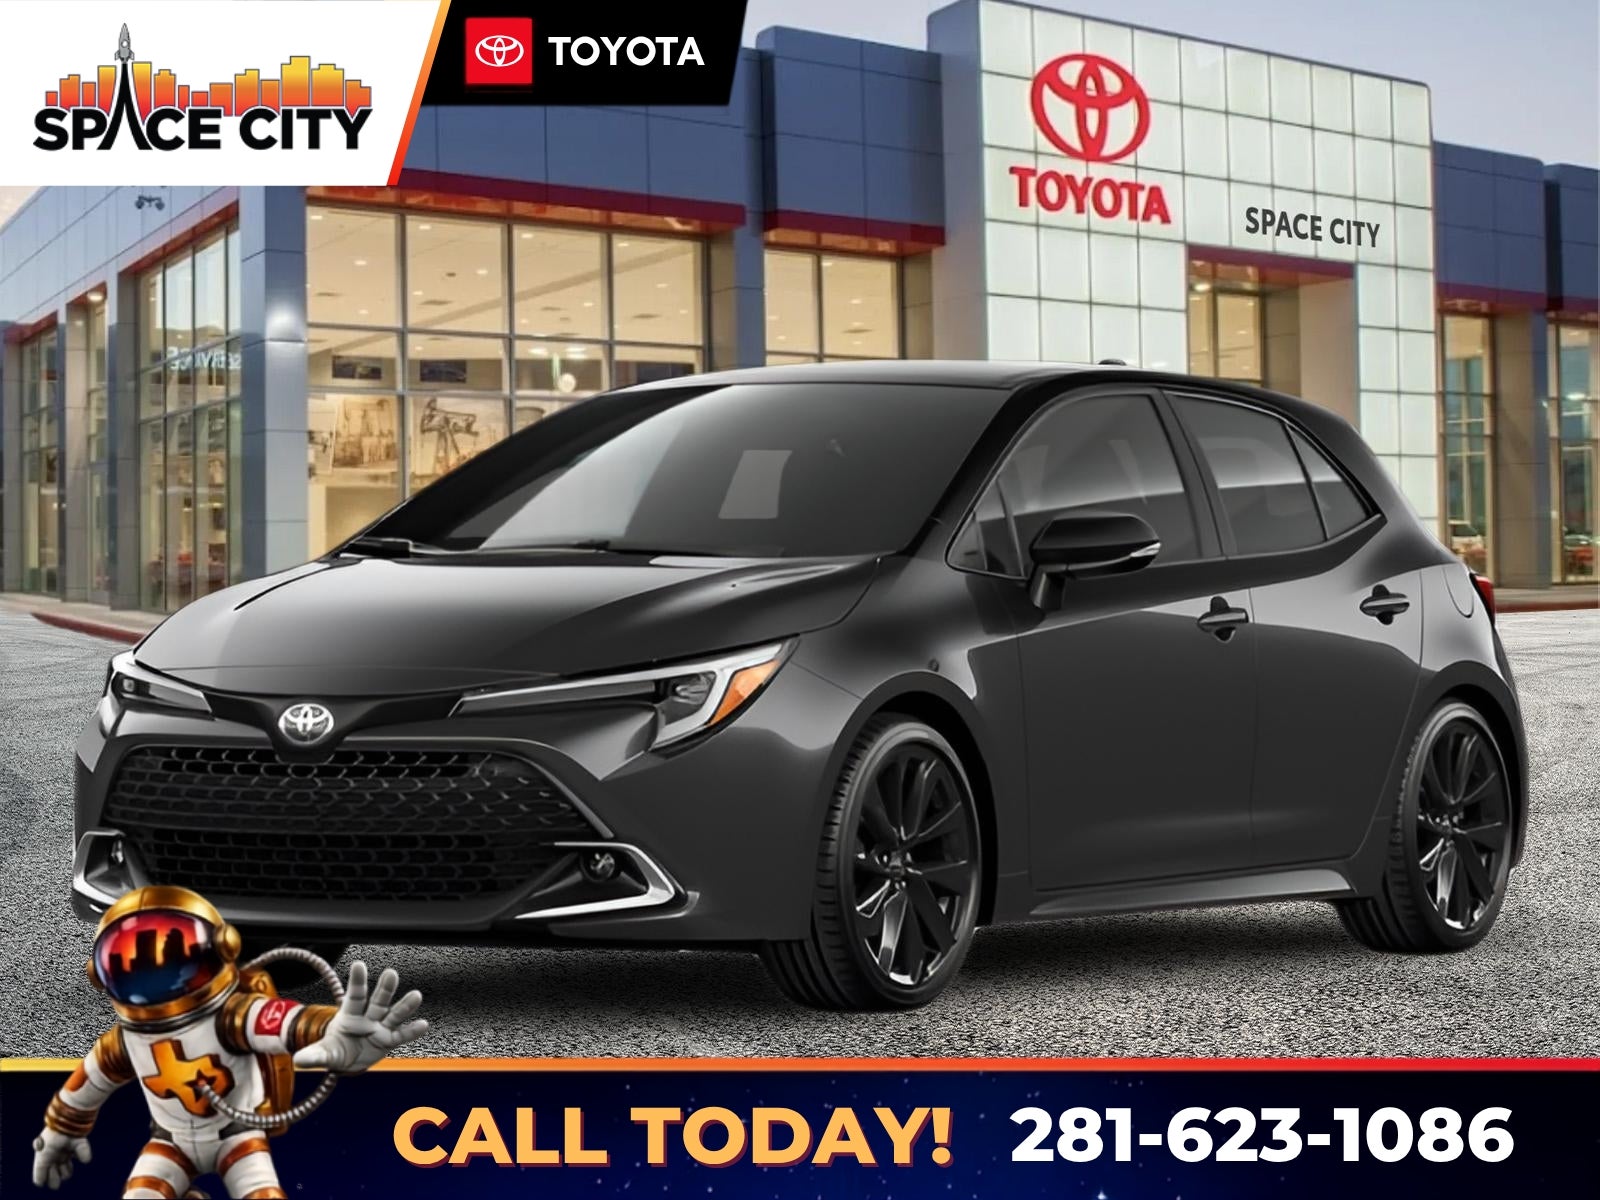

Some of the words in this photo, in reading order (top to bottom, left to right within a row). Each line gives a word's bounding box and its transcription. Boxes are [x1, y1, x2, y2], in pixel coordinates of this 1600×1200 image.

[1010, 166, 1171, 224] TOYOTA
[1245, 206, 1323, 242] SPACE
[1329, 218, 1381, 248] CITY
